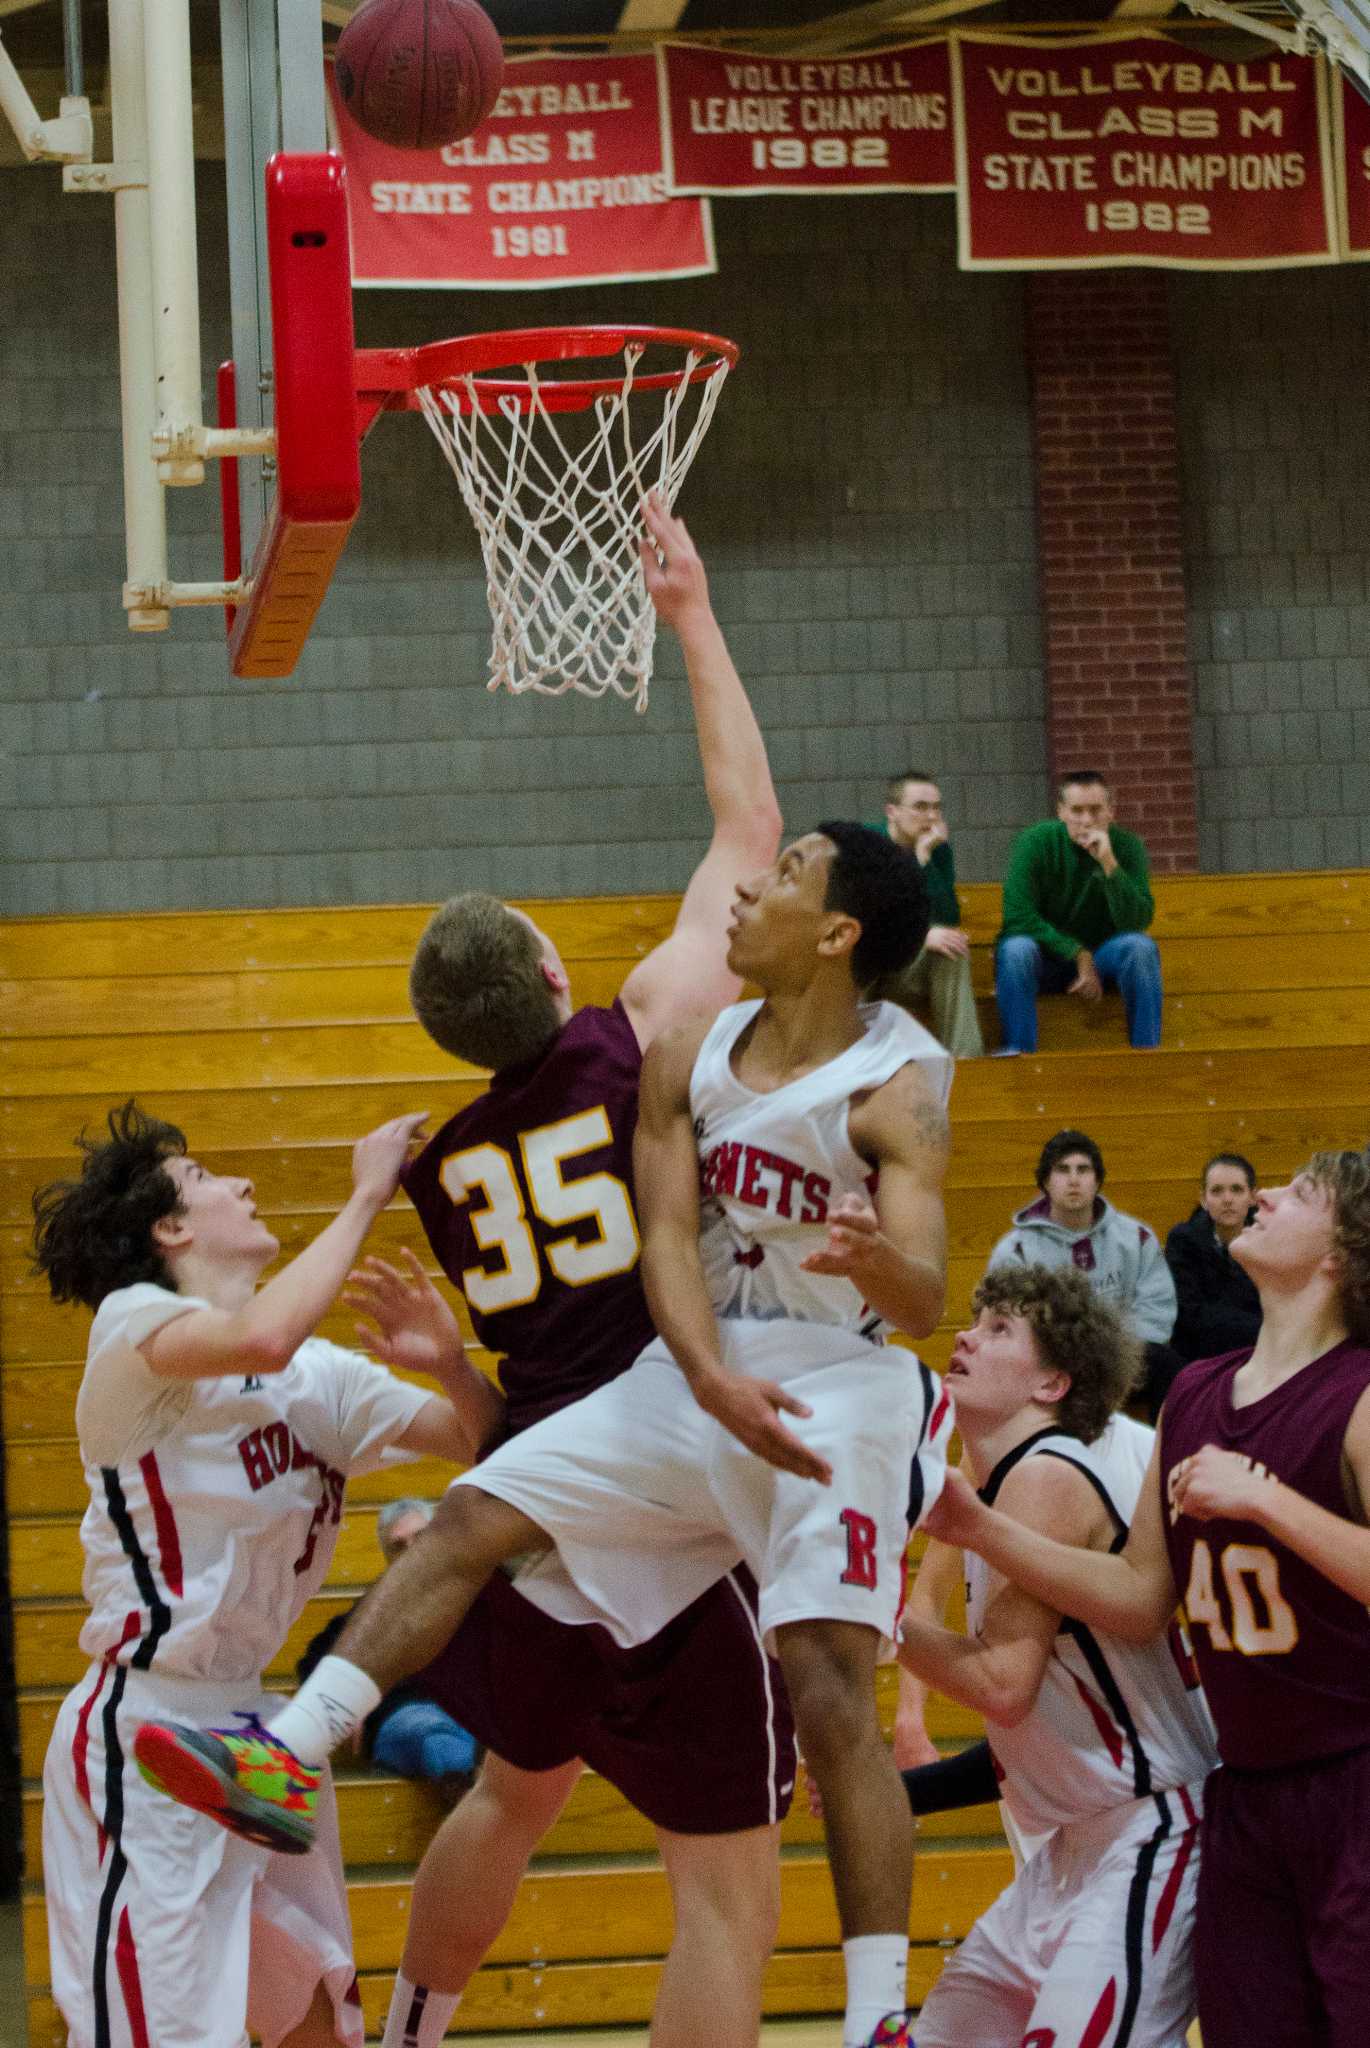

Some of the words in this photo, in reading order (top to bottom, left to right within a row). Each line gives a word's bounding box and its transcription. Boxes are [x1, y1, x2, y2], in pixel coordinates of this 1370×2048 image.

[725, 62, 911, 91] VOLLEYBALL
[988, 62, 1296, 97] VOLLEYBALL
[690, 97, 793, 133] LEAGUE
[802, 94, 946, 131] CHAMPIONS
[1006, 106, 1219, 140] CLASS
[1238, 107, 1283, 138] M
[442, 134, 549, 167] CLASS
[567, 130, 596, 162] M
[752, 138, 889, 169] 1982
[984, 154, 1098, 191] STATE
[1112, 152, 1305, 191] CHAMPIONS
[371, 182, 471, 214] STATE
[488, 172, 672, 213] CHAMPIONS
[1085, 202, 1211, 234] 1982
[491, 225, 568, 257] 1981
[438, 1105, 641, 1315] 35
[840, 1507, 877, 1592] B
[1186, 1539, 1298, 1656] 40
